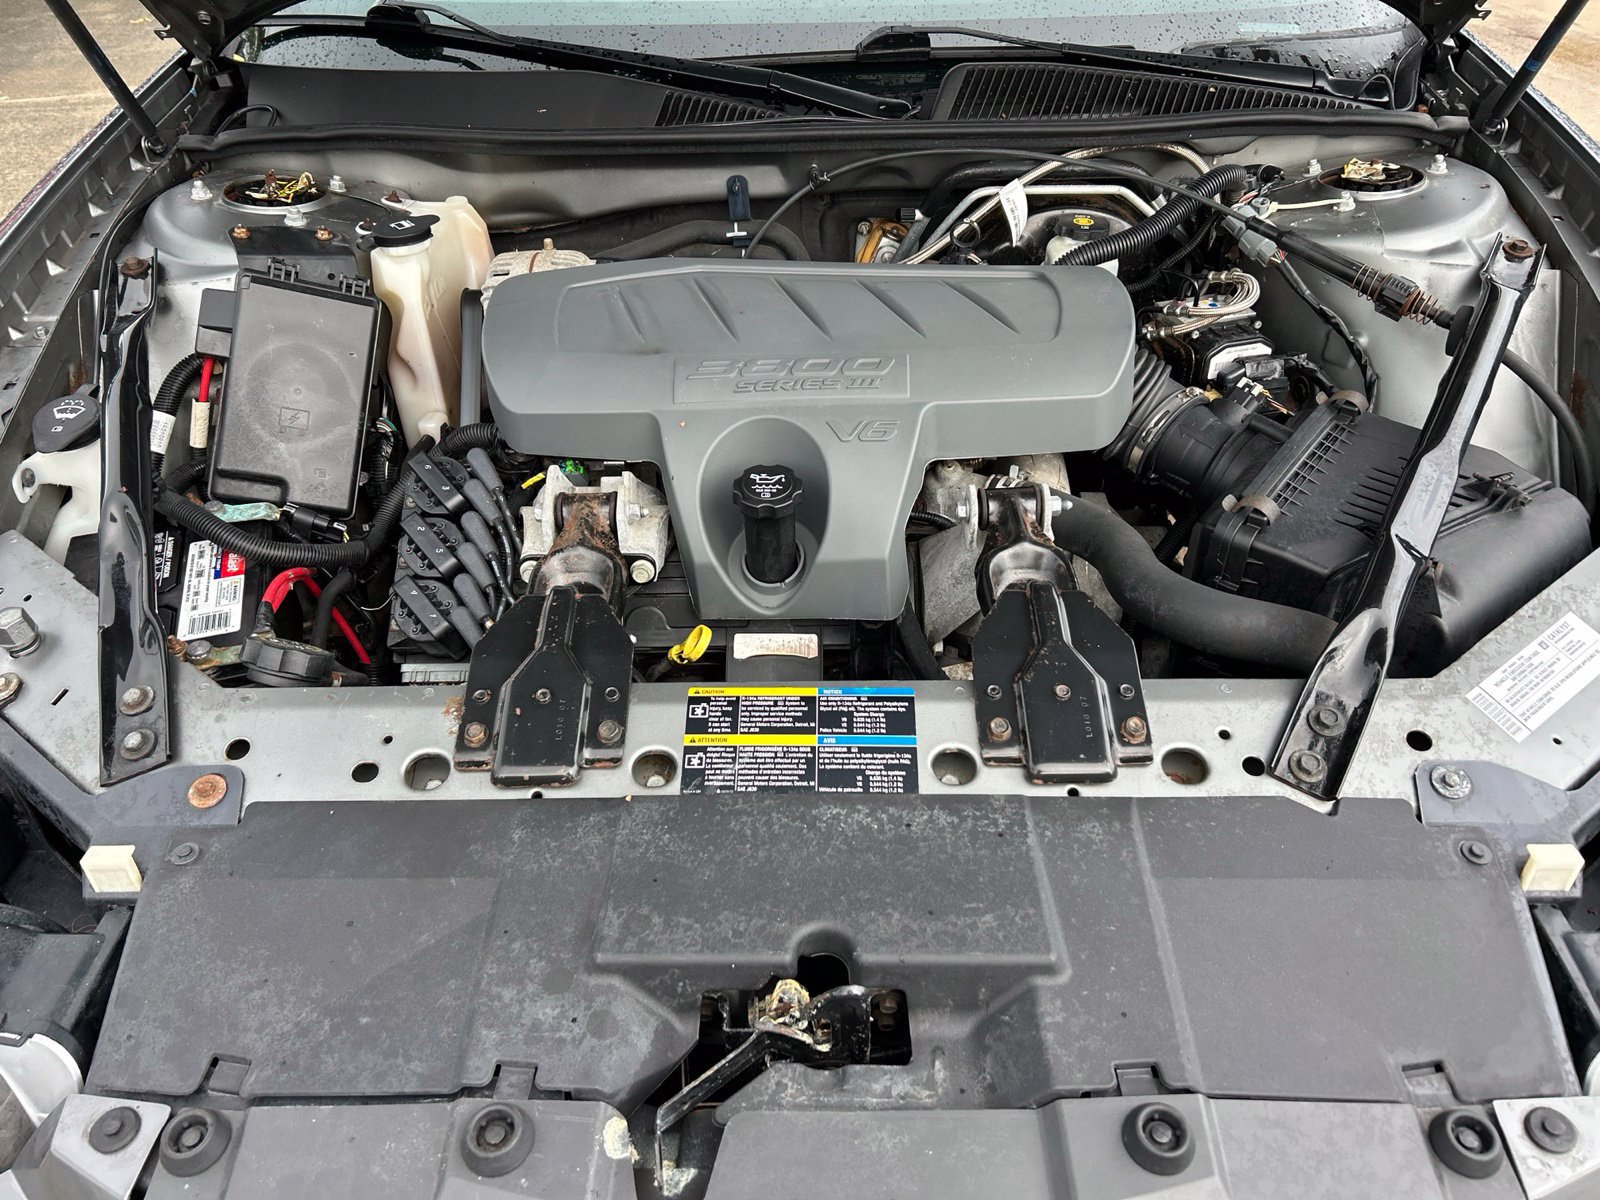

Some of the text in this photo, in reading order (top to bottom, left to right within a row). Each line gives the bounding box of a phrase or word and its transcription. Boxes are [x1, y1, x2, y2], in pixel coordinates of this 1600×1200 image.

[687, 357, 896, 380] 3800
[733, 377, 885, 393] SERIES III
[825, 416, 901, 442] V6
[228, 552, 240, 572] alast
[1546, 621, 1571, 640] CATALYST
